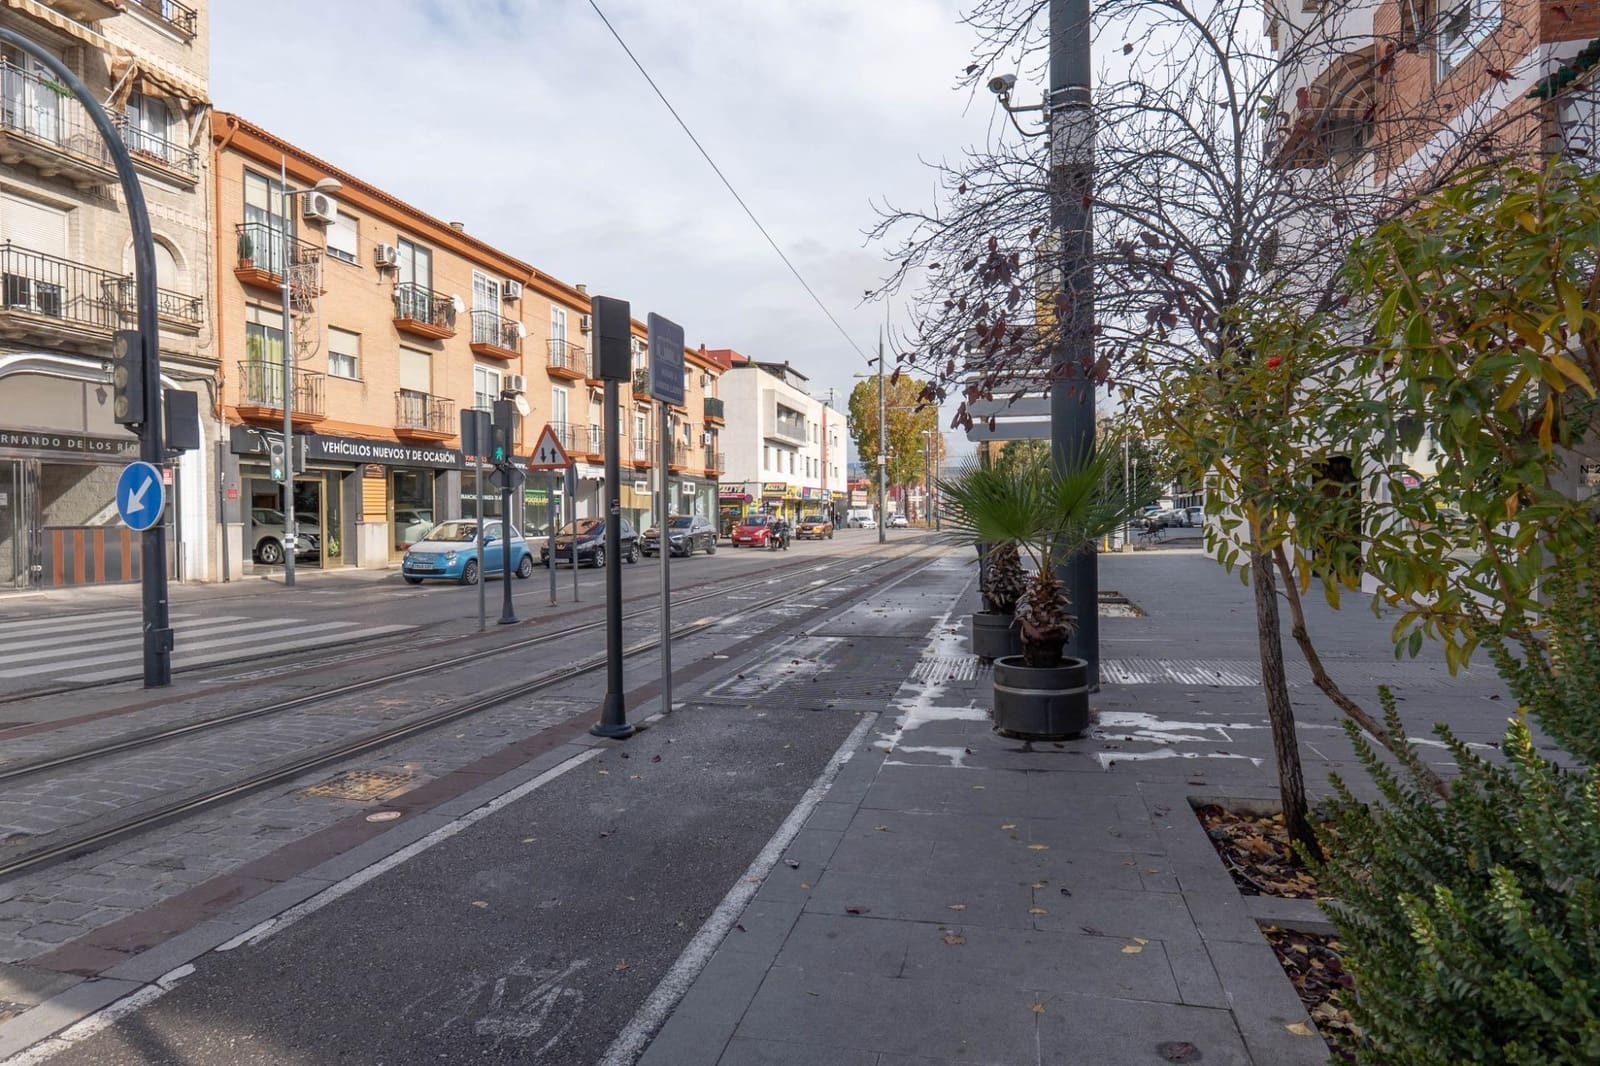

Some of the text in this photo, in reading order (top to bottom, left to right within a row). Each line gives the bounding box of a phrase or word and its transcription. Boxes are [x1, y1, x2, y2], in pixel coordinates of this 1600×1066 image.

[67, 439, 83, 448] DE
[89, 441, 111, 450] LOS
[322, 440, 371, 457] VEHÍCULOS
[372, 446, 404, 459] NUEVOS
[405, 450, 411, 459] Y
[412, 450, 422, 460] DE
[423, 450, 455, 463] OCASIÓN
